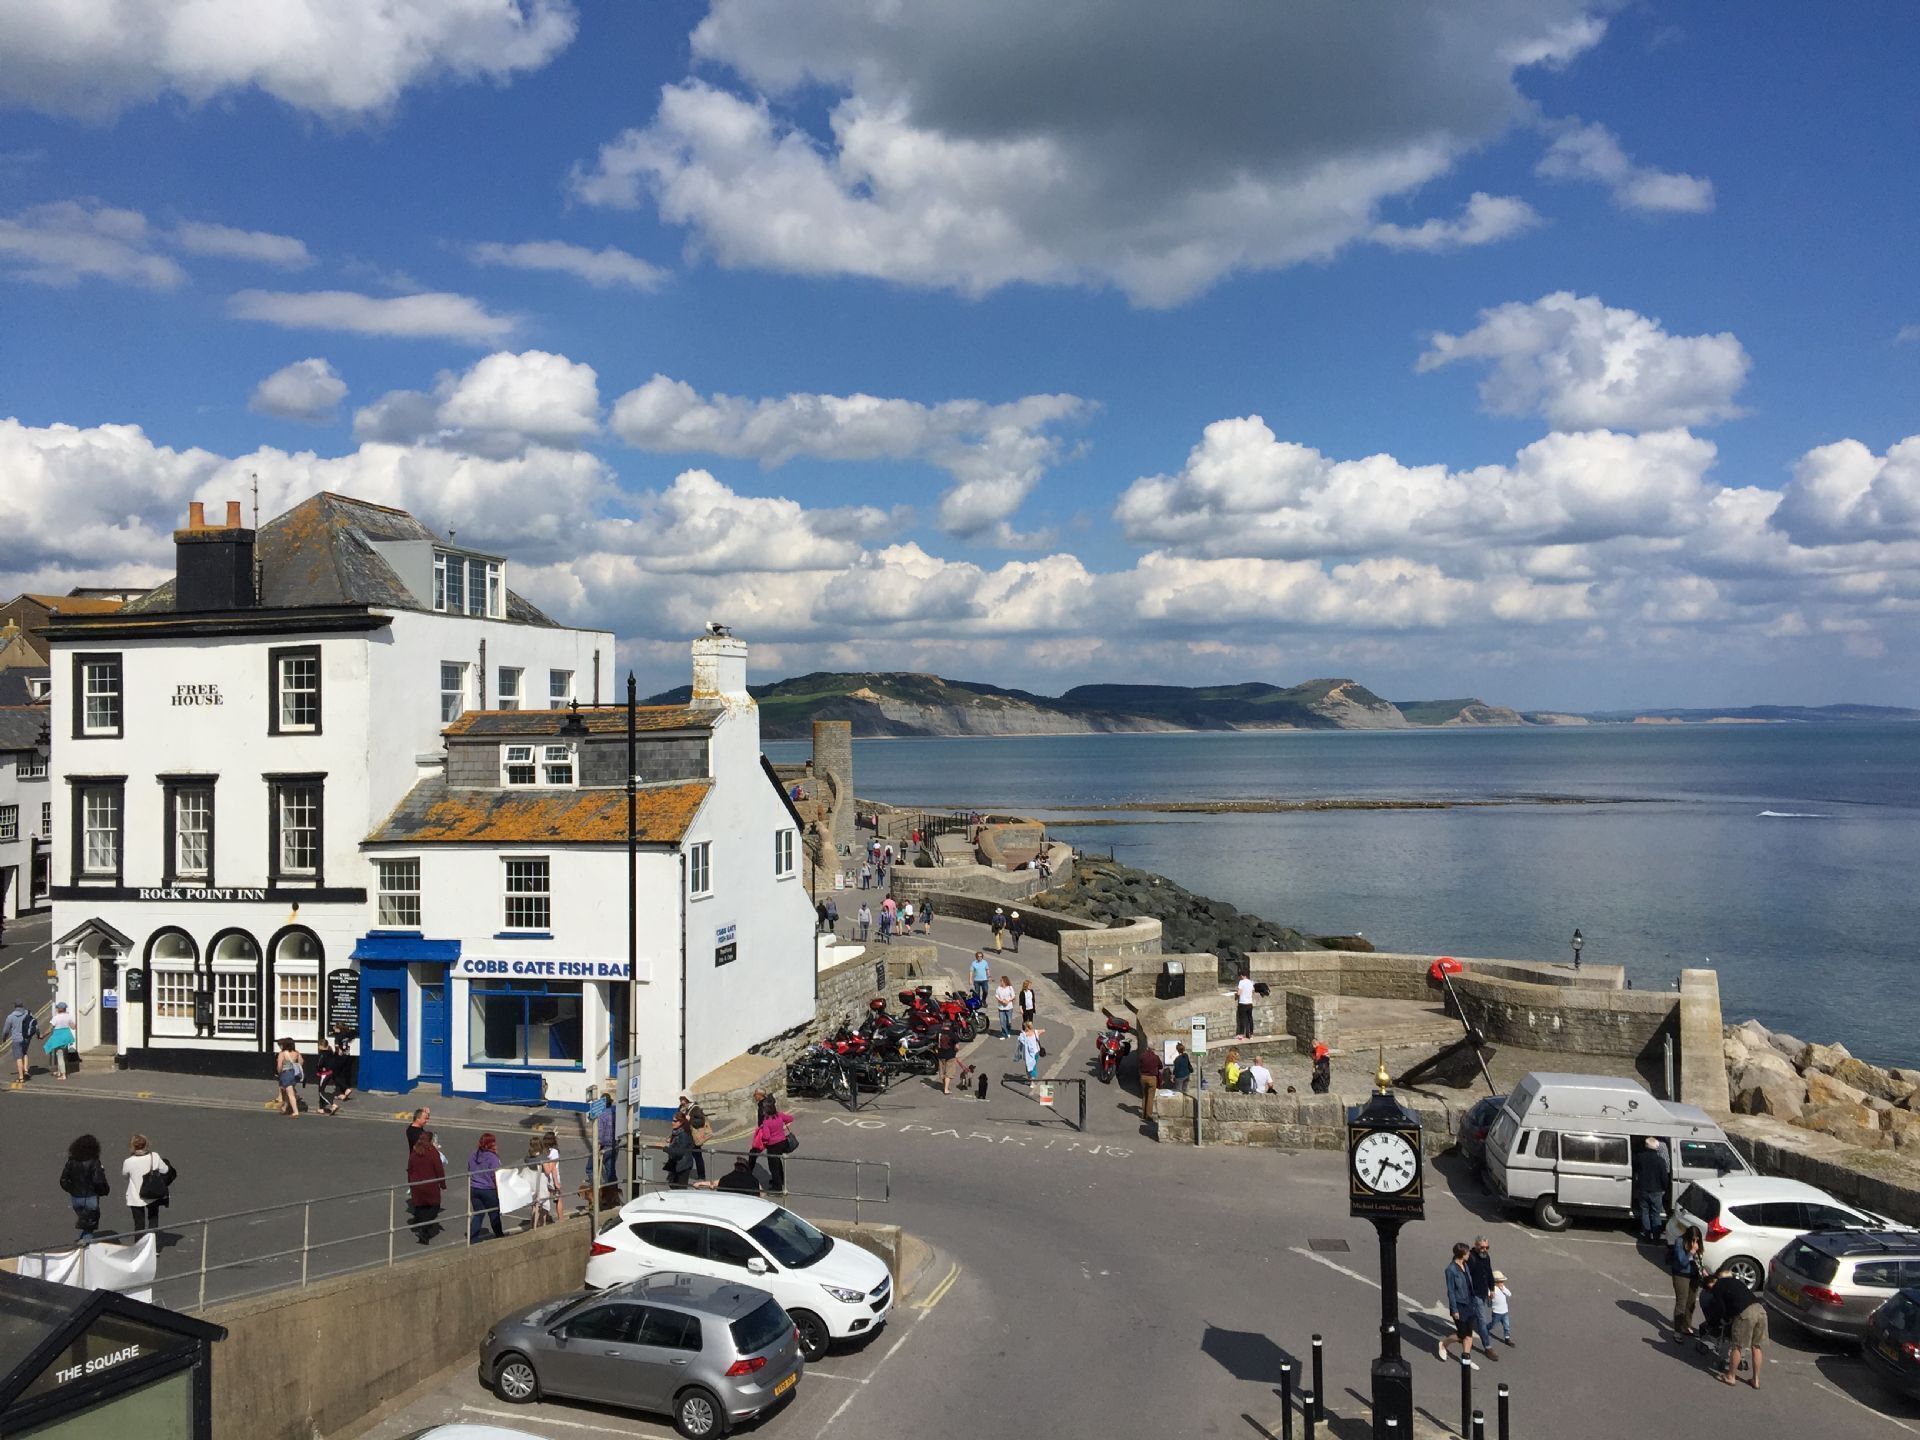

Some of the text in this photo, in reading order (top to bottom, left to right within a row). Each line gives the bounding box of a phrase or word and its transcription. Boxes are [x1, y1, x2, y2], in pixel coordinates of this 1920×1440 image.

[176, 684, 219, 696] FREE
[171, 695, 223, 706] HOUSE
[139, 888, 265, 900] ROCK POINT INN
[463, 960, 508, 973] COBB
[513, 961, 555, 975] GATE
[559, 962, 593, 976] FISH
[823, 1117, 887, 1129] NO
[55, 1344, 140, 1384] THE SQUARE
